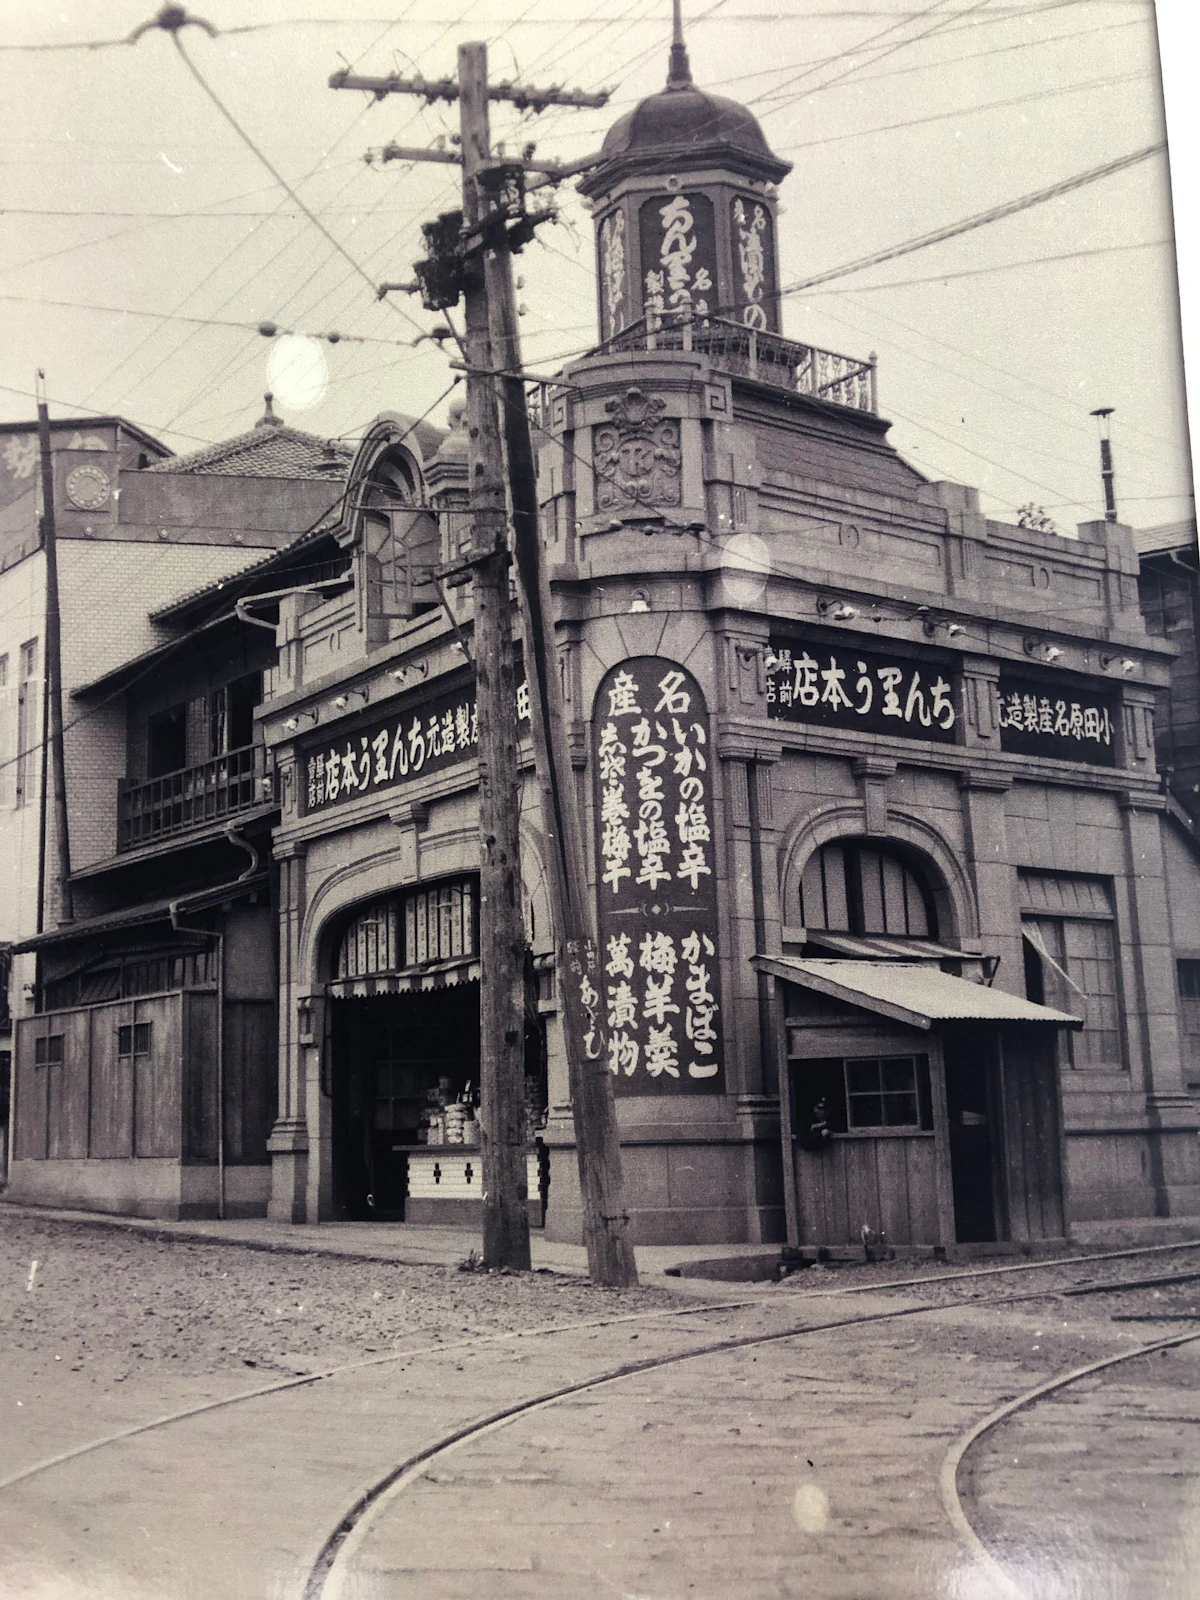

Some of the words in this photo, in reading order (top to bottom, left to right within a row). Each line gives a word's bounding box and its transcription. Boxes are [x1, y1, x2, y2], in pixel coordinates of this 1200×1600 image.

[793, 650, 955, 730] ちん里う本店
[672, 718, 712, 890] いかの塩辛
[681, 930, 719, 1079] かまぼこ
